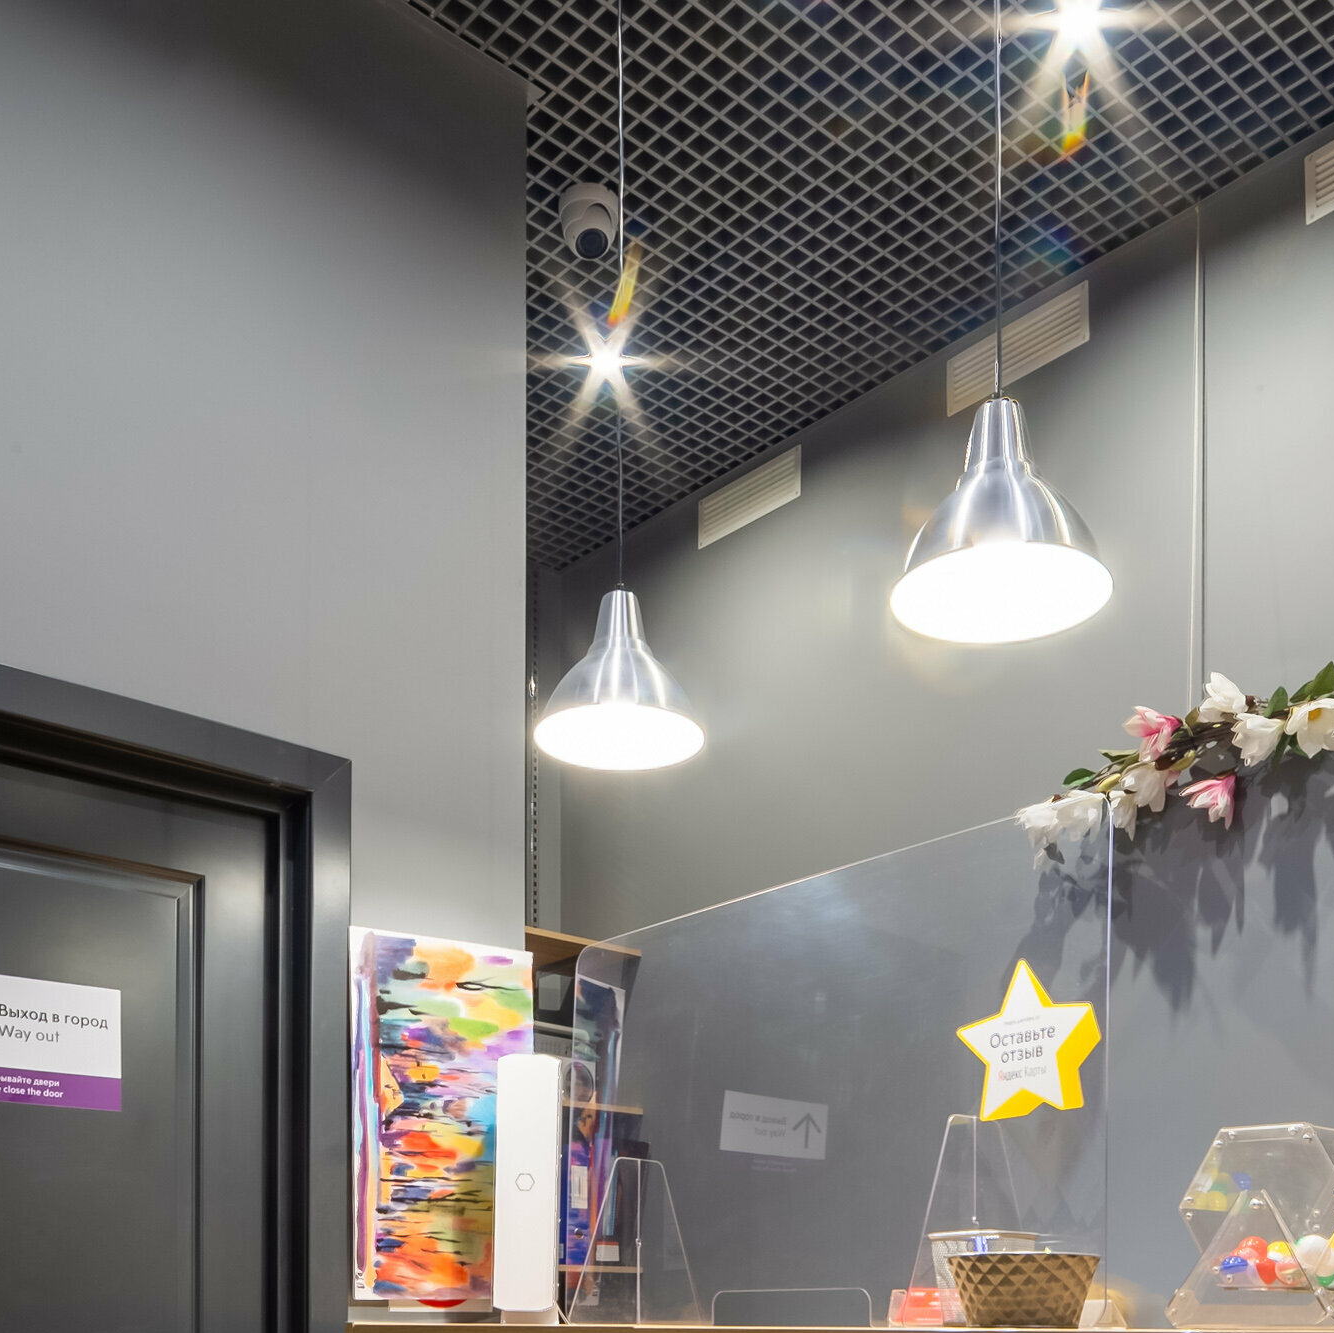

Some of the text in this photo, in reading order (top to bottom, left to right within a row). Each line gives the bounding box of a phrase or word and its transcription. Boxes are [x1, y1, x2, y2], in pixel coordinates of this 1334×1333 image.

[52, 1014, 60, 1023] в
[64, 1015, 108, 1029] город
[35, 1031, 60, 1042] out
[990, 1026, 1055, 1048] Оставьте
[1001, 1046, 1043, 1063] отзыв
[998, 1069, 1022, 1081] Яндекс
[33, 1078, 59, 1088] двери
[3, 1086, 25, 1095] close
[27, 1088, 41, 1096] the
[43, 1089, 63, 1098] door
